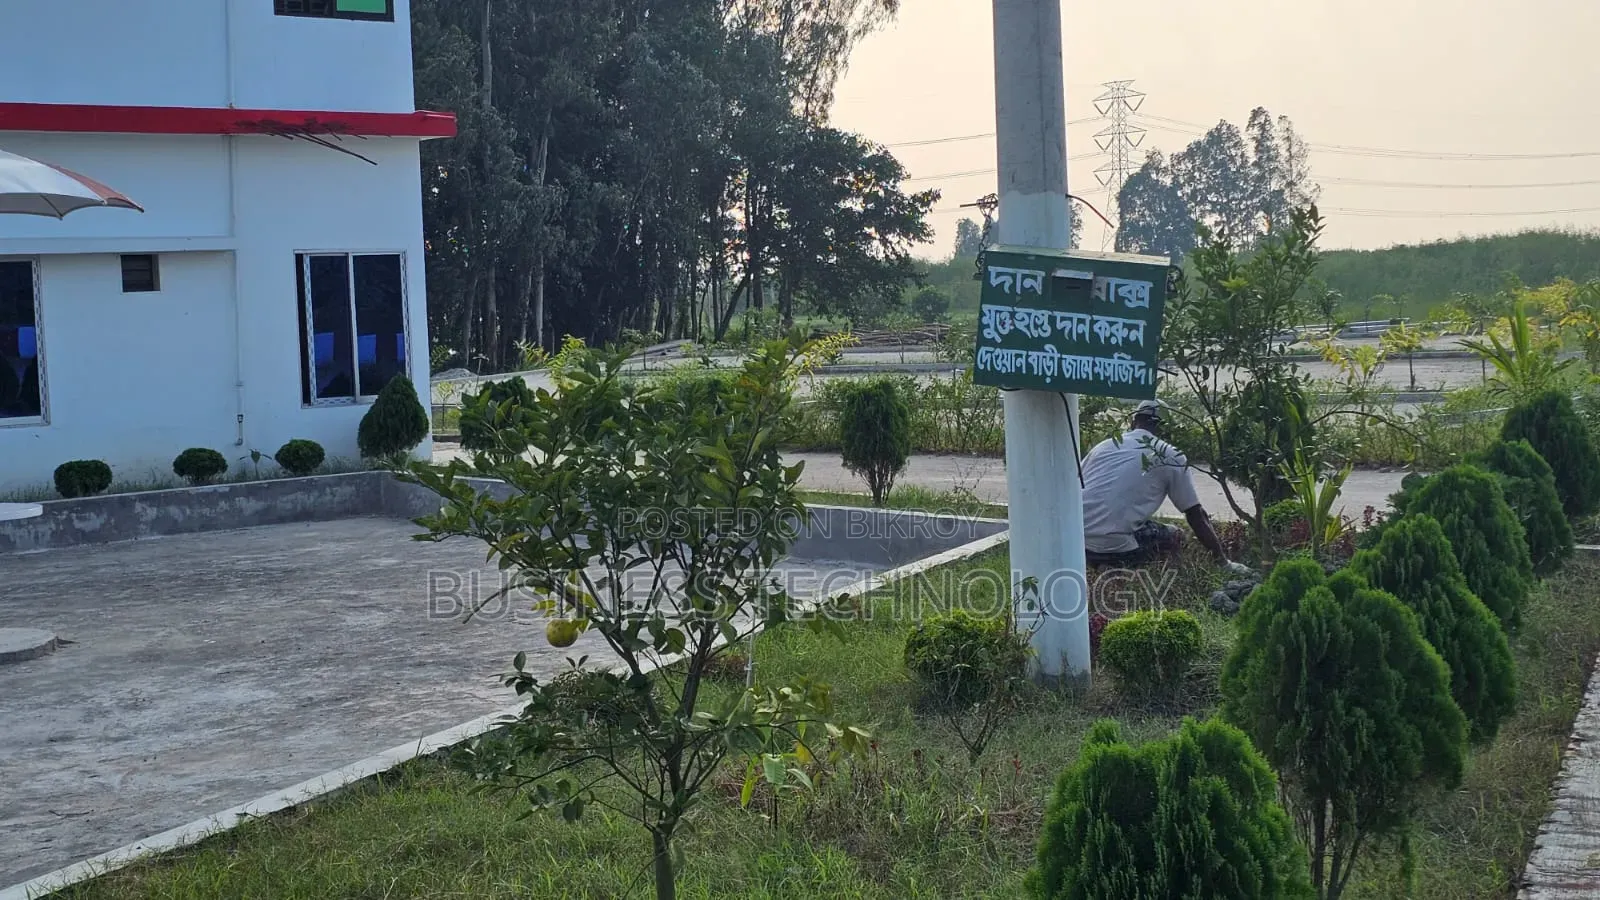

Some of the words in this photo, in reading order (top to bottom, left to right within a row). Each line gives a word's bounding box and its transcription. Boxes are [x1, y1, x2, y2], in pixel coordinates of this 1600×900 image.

[988, 265, 1045, 295] দান
[1013, 307, 1051, 338] হস্তে
[1052, 311, 1091, 343] দান
[1093, 315, 1146, 347] করুন
[977, 346, 1026, 374] দেওয়ান
[1028, 343, 1060, 384] বাড়ী
[1061, 354, 1094, 381] জামে
